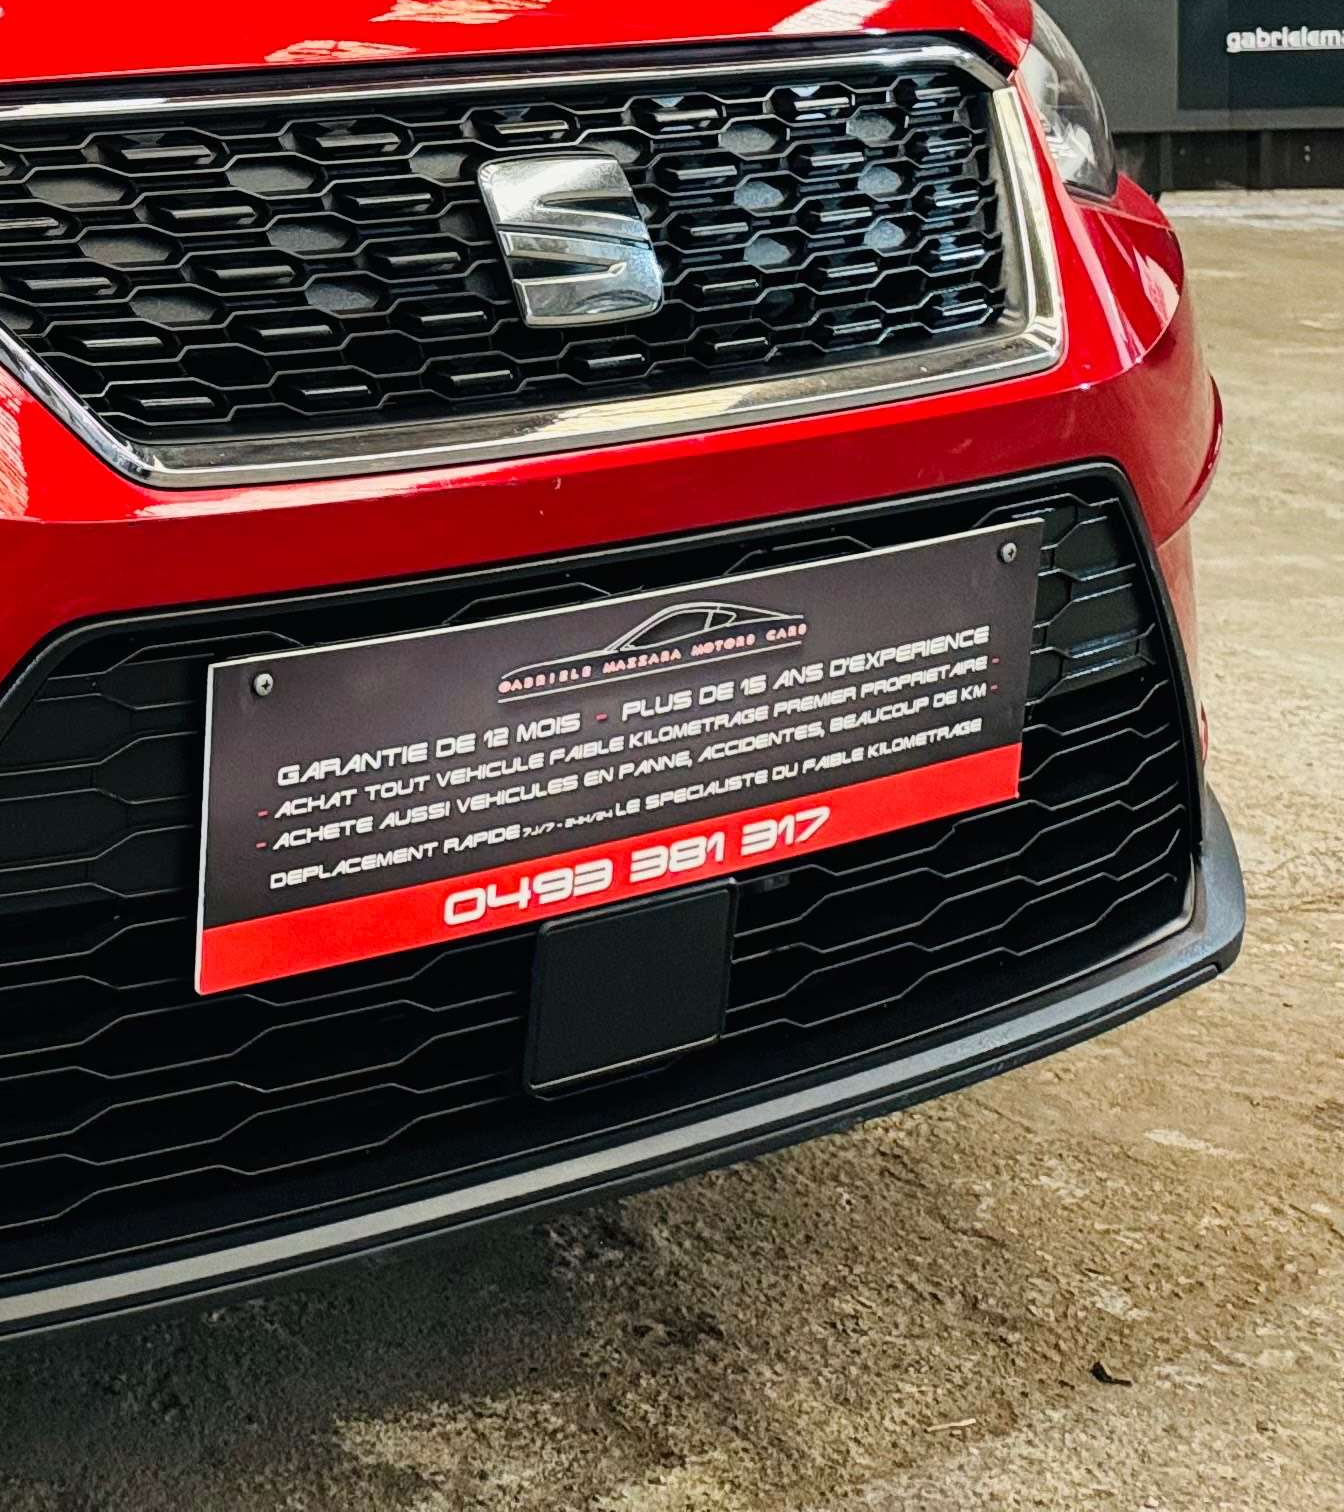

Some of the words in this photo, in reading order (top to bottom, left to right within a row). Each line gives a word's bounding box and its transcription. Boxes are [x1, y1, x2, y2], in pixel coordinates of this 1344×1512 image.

[1225, 25, 1344, 54] gabrielem
[272, 816, 374, 851] ACHETE
[379, 801, 452, 830] AUSSI
[456, 774, 579, 814] VEHICULES
[583, 766, 614, 788] EN
[829, 696, 930, 734] BEAUCOUP
[932, 688, 959, 707] DE
[961, 683, 987, 701] KM
[274, 788, 358, 819] ACHAT
[364, 775, 431, 802] TOUT
[436, 752, 545, 788] VEHICULE
[549, 735, 625, 765] FAIBLE
[628, 705, 769, 749] KILOMETRAGE
[773, 687, 857, 718] PREMIER
[860, 656, 989, 699] PROPRIETAIRE
[277, 742, 429, 788] GARANTIE
[435, 733, 477, 758] DE
[483, 726, 510, 750] 12
[515, 712, 582, 743] MOIS
[621, 694, 693, 722] PLUS
[698, 681, 736, 707] DE
[740, 674, 767, 698] 15
[772, 662, 824, 690] ANS
[270, 841, 438, 890] DEPLACEMENT
[442, 824, 521, 854] RAPIDE
[615, 792, 641, 816] LE
[645, 768, 769, 810] SPECIALISTE
[772, 762, 799, 781] DU
[801, 744, 865, 774] FAIBLE
[867, 717, 983, 759] KILOMETRAGE
[443, 857, 614, 926] 0493
[628, 831, 726, 884] 381
[739, 806, 831, 857] 317
